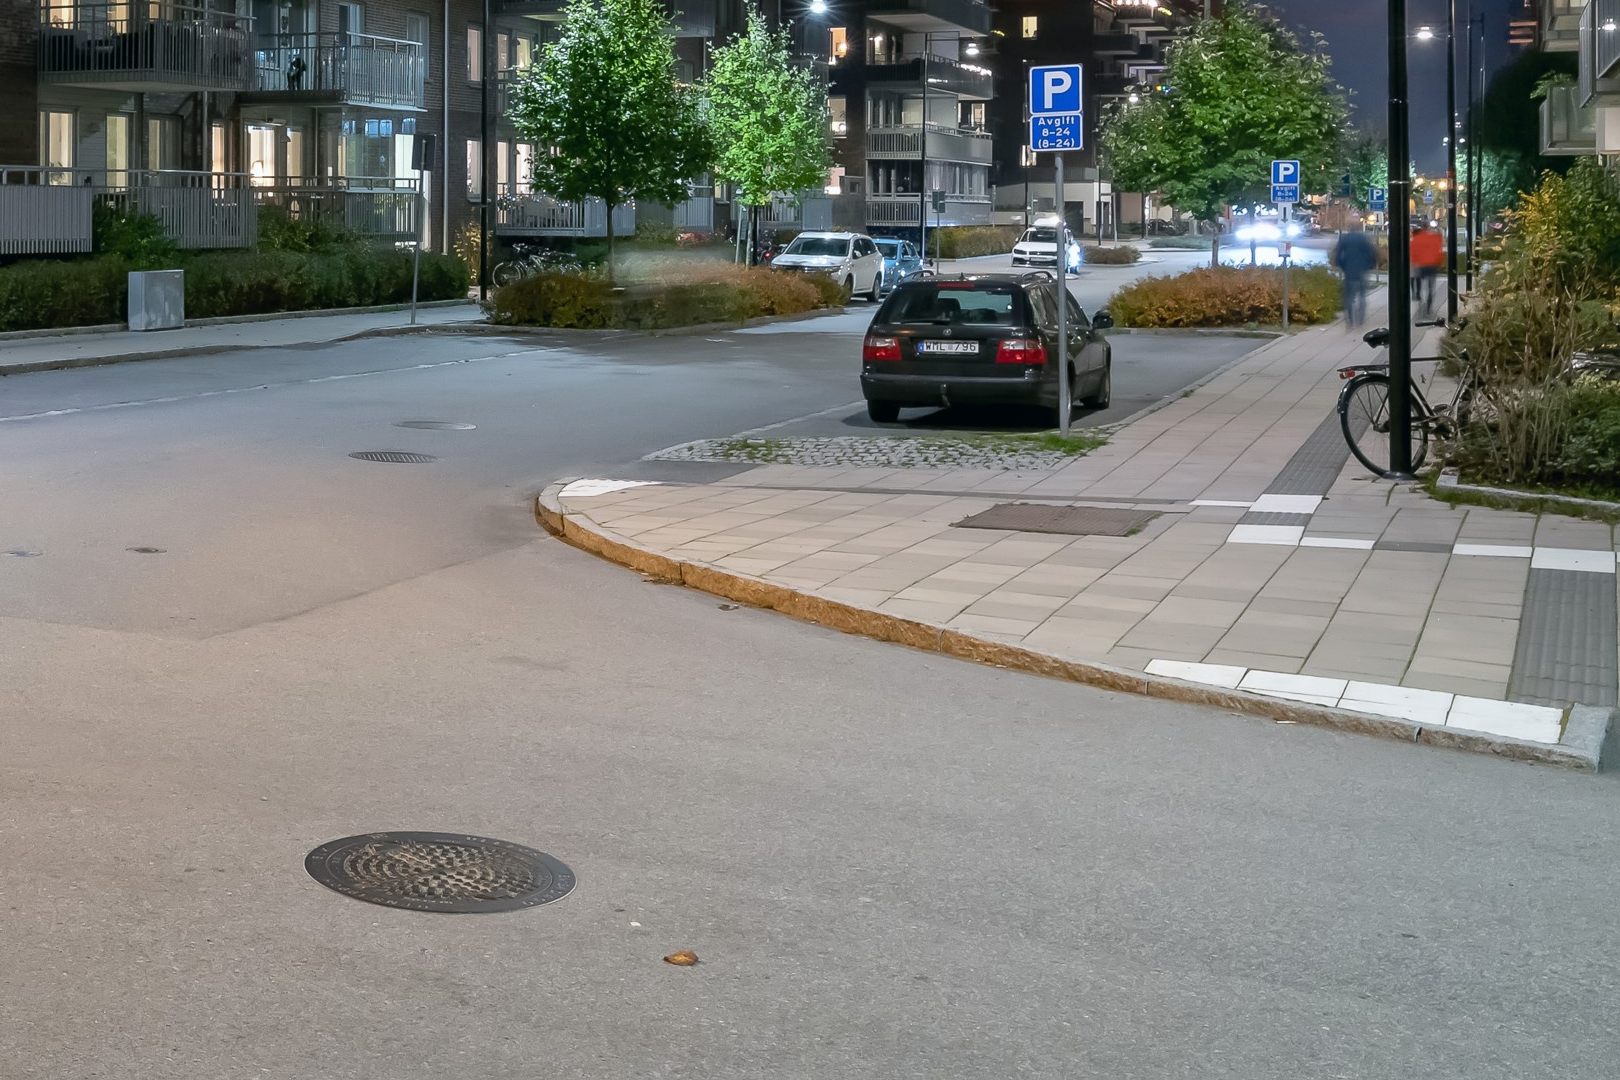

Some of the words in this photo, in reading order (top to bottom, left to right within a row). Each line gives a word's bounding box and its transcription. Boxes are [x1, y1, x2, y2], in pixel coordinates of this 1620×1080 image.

[1044, 70, 1072, 109] P
[1038, 116, 1075, 127] Avgift
[1042, 127, 1070, 137] 8-24
[1038, 138, 1075, 149] (8-24)
[1279, 163, 1295, 183] P
[1373, 189, 1383, 201] P
[925, 341, 946, 351] WML
[954, 341, 976, 352] 796
